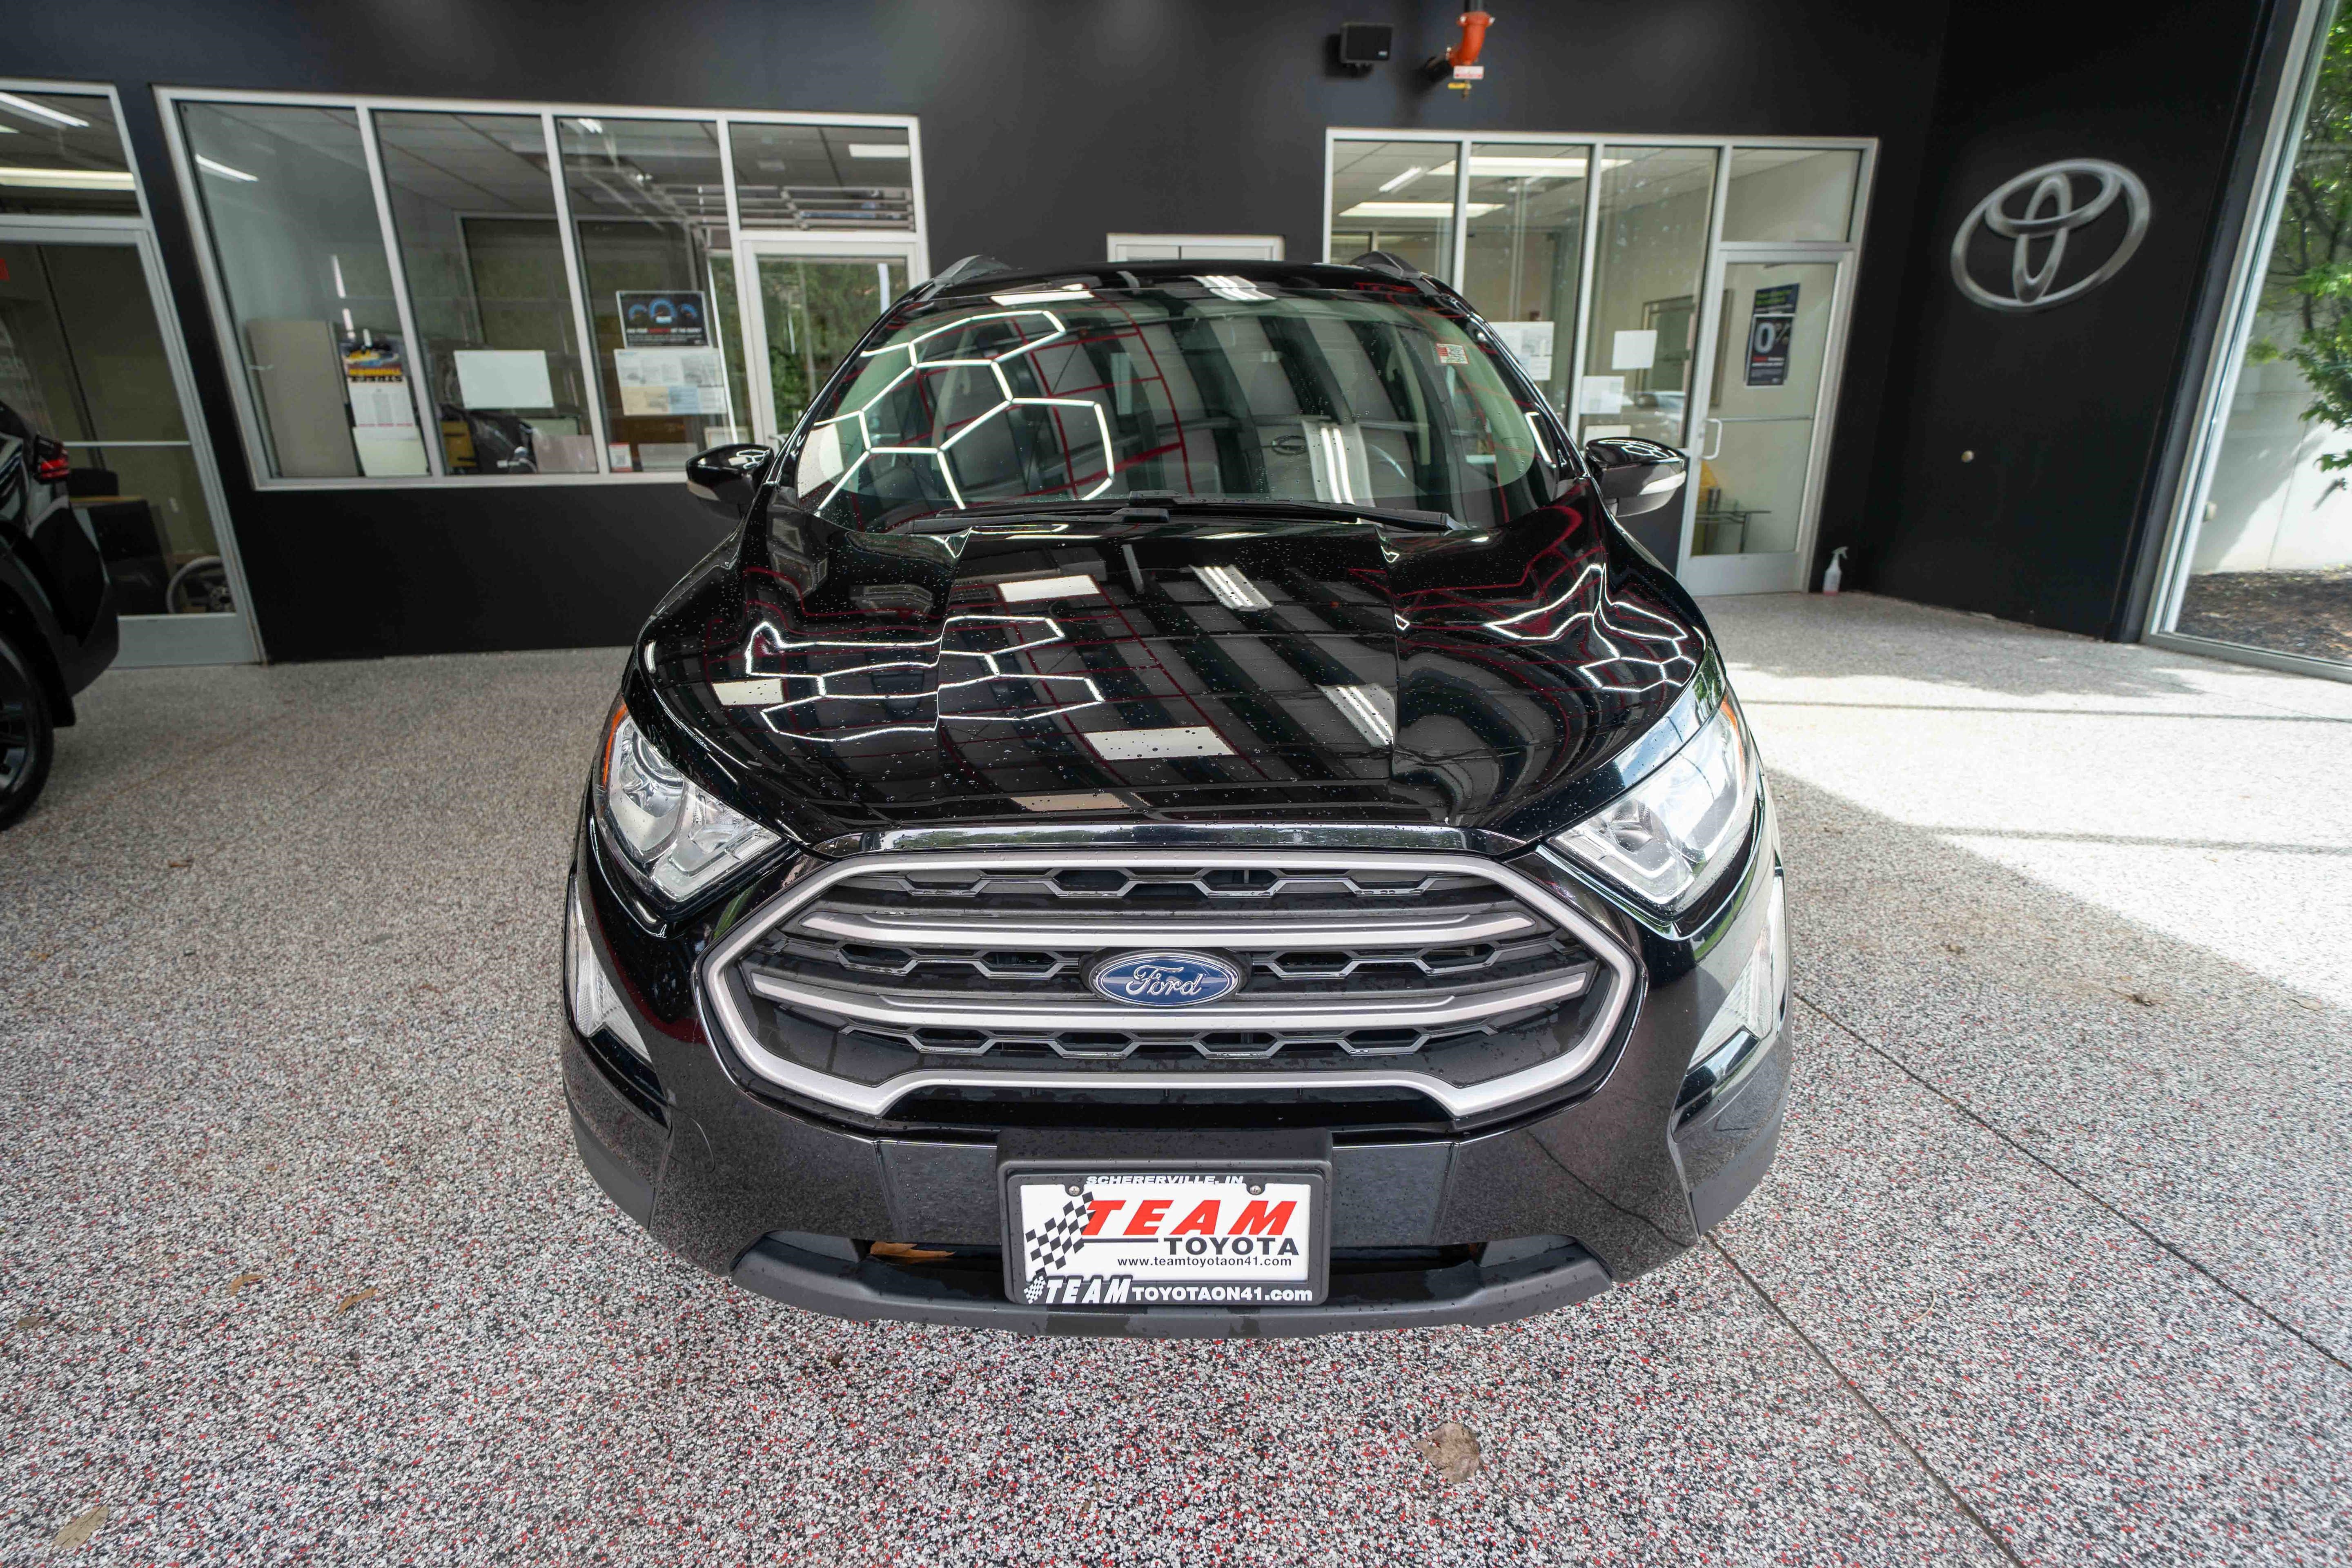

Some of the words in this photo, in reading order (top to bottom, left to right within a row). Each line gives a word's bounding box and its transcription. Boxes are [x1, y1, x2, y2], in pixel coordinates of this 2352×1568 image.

[1125, 964, 1204, 996] Ford
[1086, 1176, 1219, 1185] SCHERERVILLE,
[1225, 1176, 1244, 1184] IN
[1081, 1199, 1297, 1236] TEAM
[1163, 1237, 1299, 1256] TOYOTA
[1117, 1256, 1292, 1267] www.teamtoyotaon41.com
[1045, 1278, 1133, 1304] TEAM
[1132, 1287, 1312, 1301] TOYOTAON41.com
